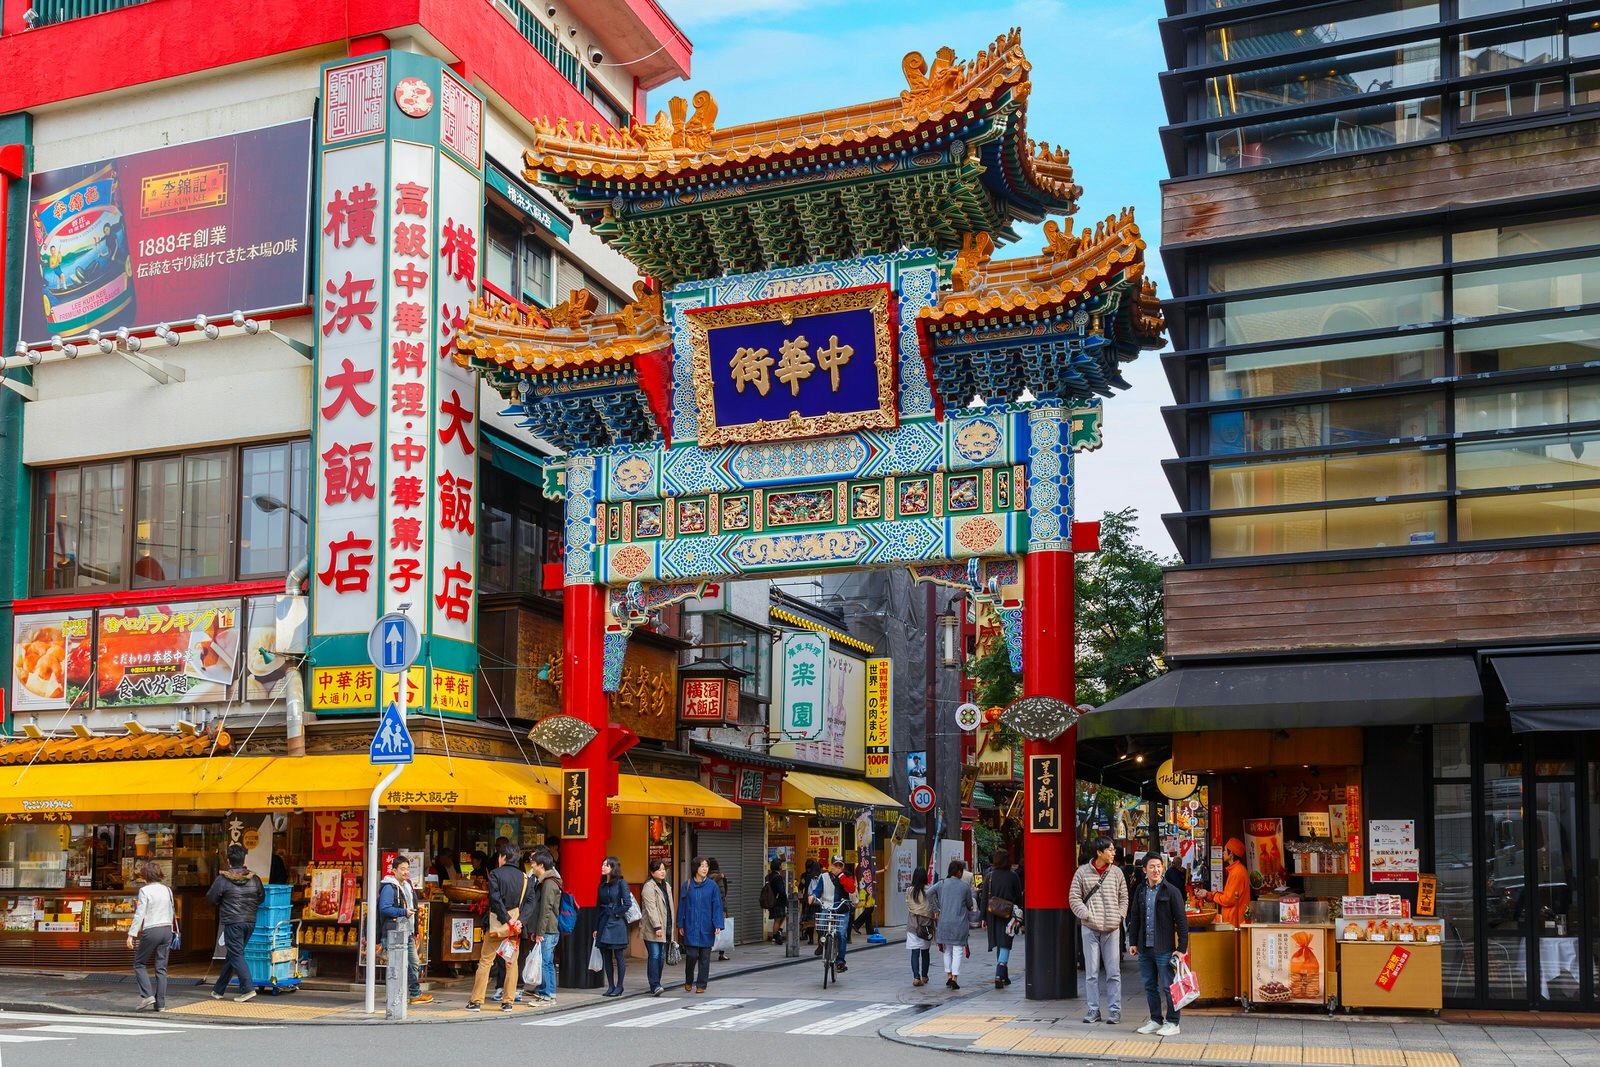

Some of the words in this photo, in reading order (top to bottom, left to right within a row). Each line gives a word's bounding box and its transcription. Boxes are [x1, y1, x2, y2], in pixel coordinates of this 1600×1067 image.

[161, 175, 207, 199] 李錦記
[138, 225, 227, 257] 1888年創業
[137, 238, 298, 278] 伝統を守り続けてきた本場の味
[729, 335, 855, 397] 中華街
[317, 182, 378, 594] 横浜大飯店
[389, 181, 430, 593] 高級中華料理・中華菓子
[113, 650, 193, 665] こだわりの本格中華
[116, 674, 188, 700] 食べ放題
[318, 671, 374, 691] 中華街
[433, 673, 470, 697] 中華街
[318, 691, 373, 705] 大通り入口
[791, 661, 816, 728] 楽園
[868, 664, 878, 742] 世界一の肉まん
[879, 660, 889, 746] 中国料理世界チャンピオン
[686, 699, 719, 715] 大飯店
[867, 755, 889, 765] 100円
[1158, 774, 1173, 785] The
[1172, 772, 1196, 786] CAFE
[387, 791, 459, 804] 横浜大飯店
[916, 792, 931, 805] 30
